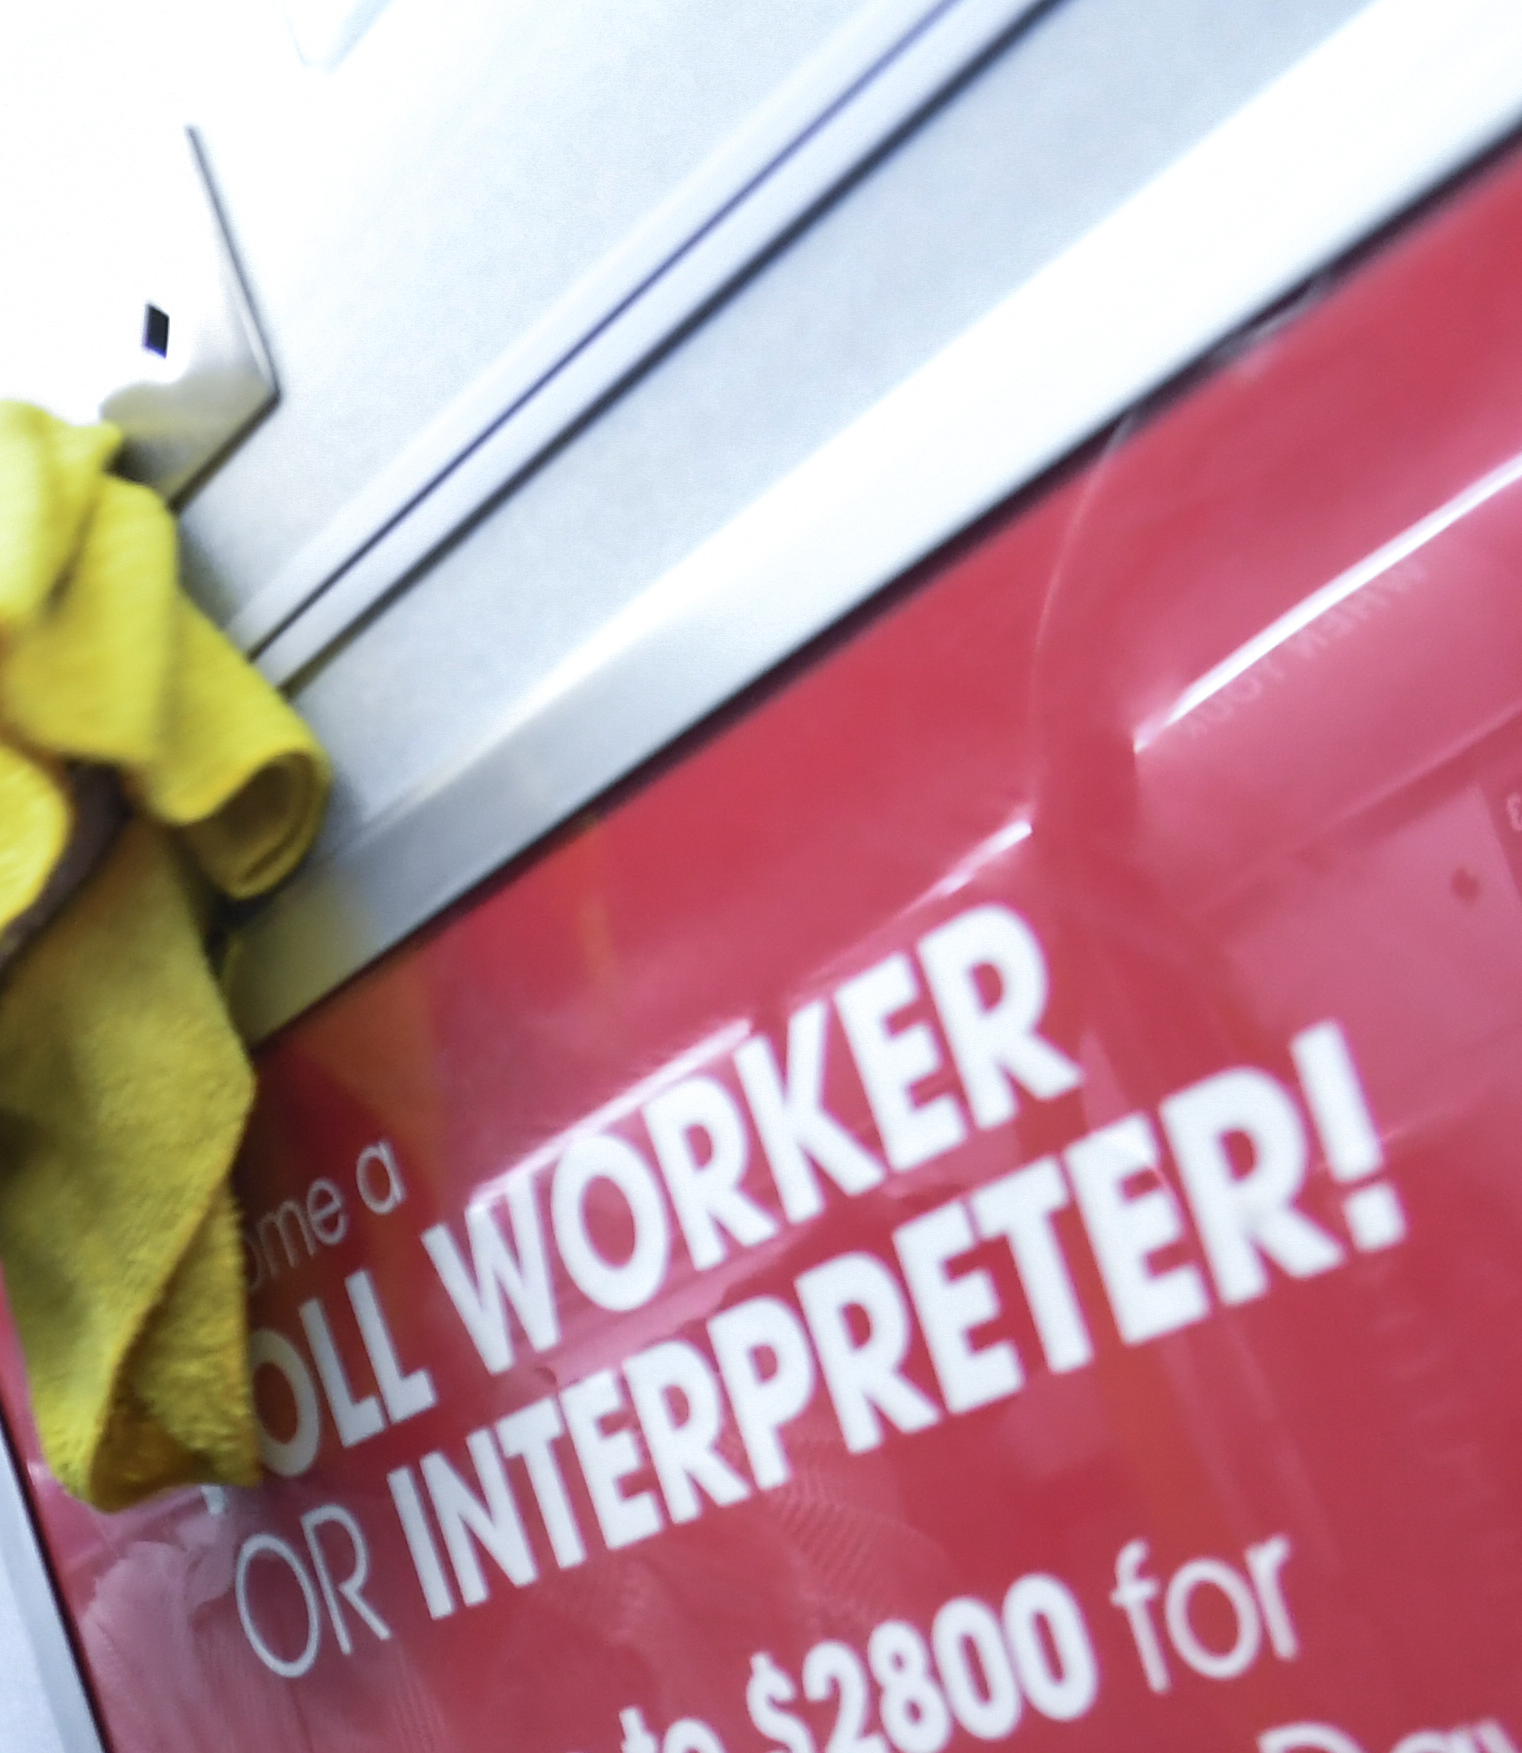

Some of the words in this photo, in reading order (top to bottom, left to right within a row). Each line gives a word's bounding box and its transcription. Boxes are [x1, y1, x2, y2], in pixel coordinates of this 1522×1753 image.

[201, 1268, 438, 1518] OLL
[421, 905, 1082, 1377] WORKER
[234, 1503, 393, 1679] OR
[388, 1020, 1407, 1622] INTERPRETER!
[356, 1141, 406, 1216] a
[1110, 1534, 1299, 1693] for
